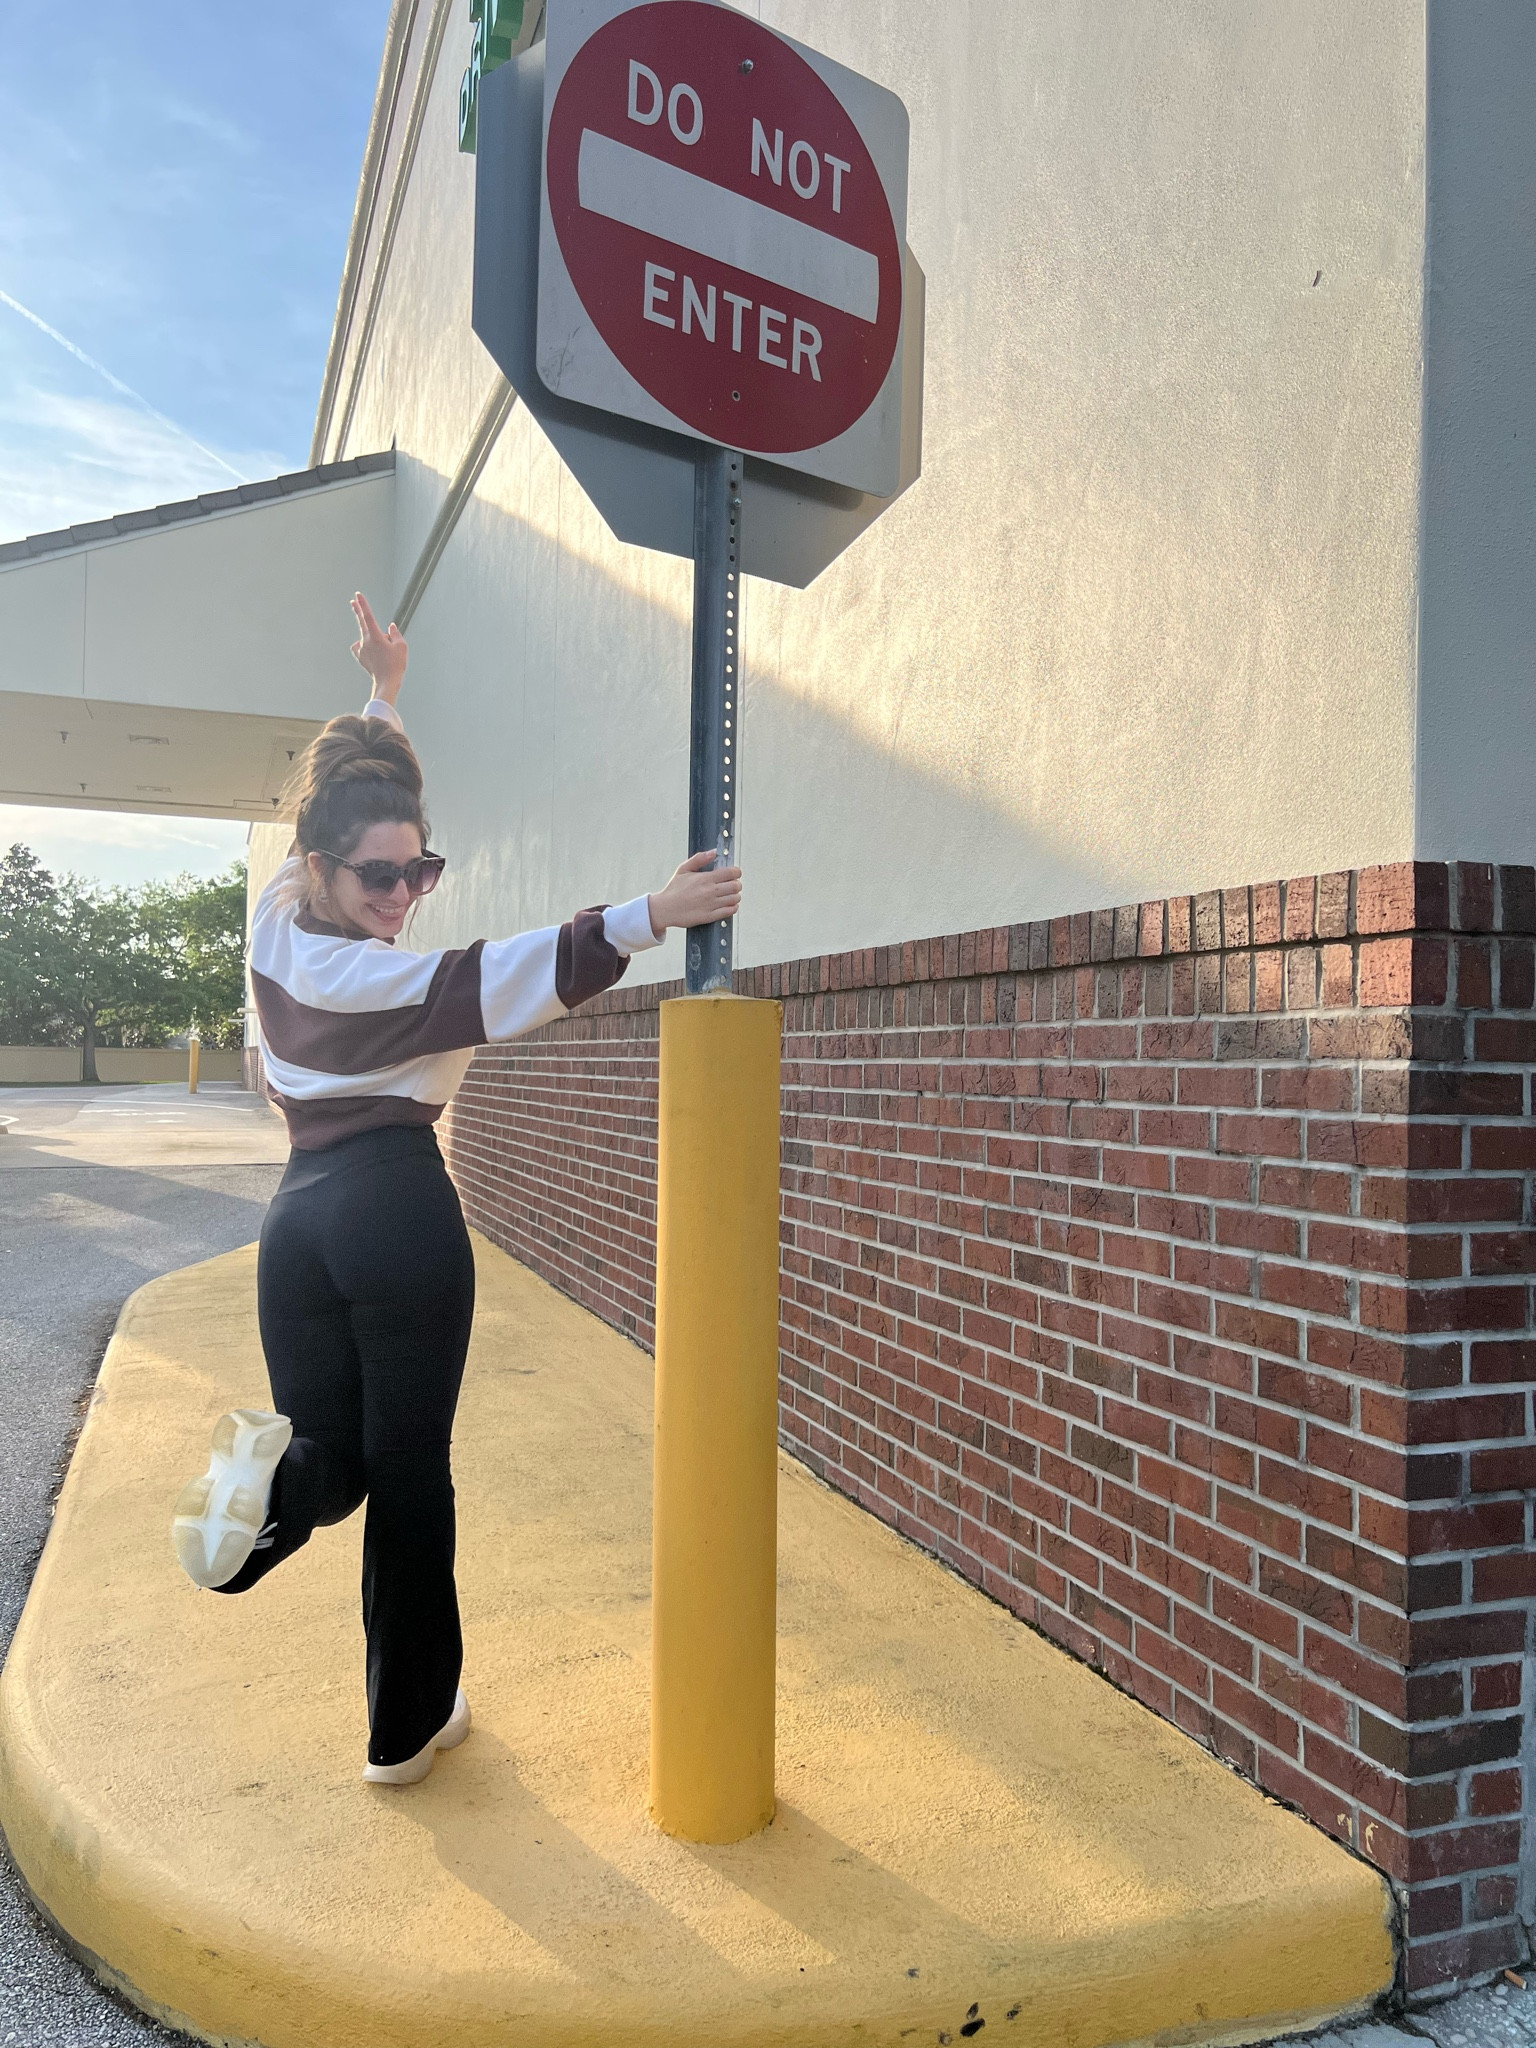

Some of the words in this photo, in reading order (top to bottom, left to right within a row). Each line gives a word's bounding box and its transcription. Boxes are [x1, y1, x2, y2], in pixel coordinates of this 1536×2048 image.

[627, 58, 704, 146] DO
[750, 117, 851, 214] NOT
[643, 260, 823, 383] ENTER
